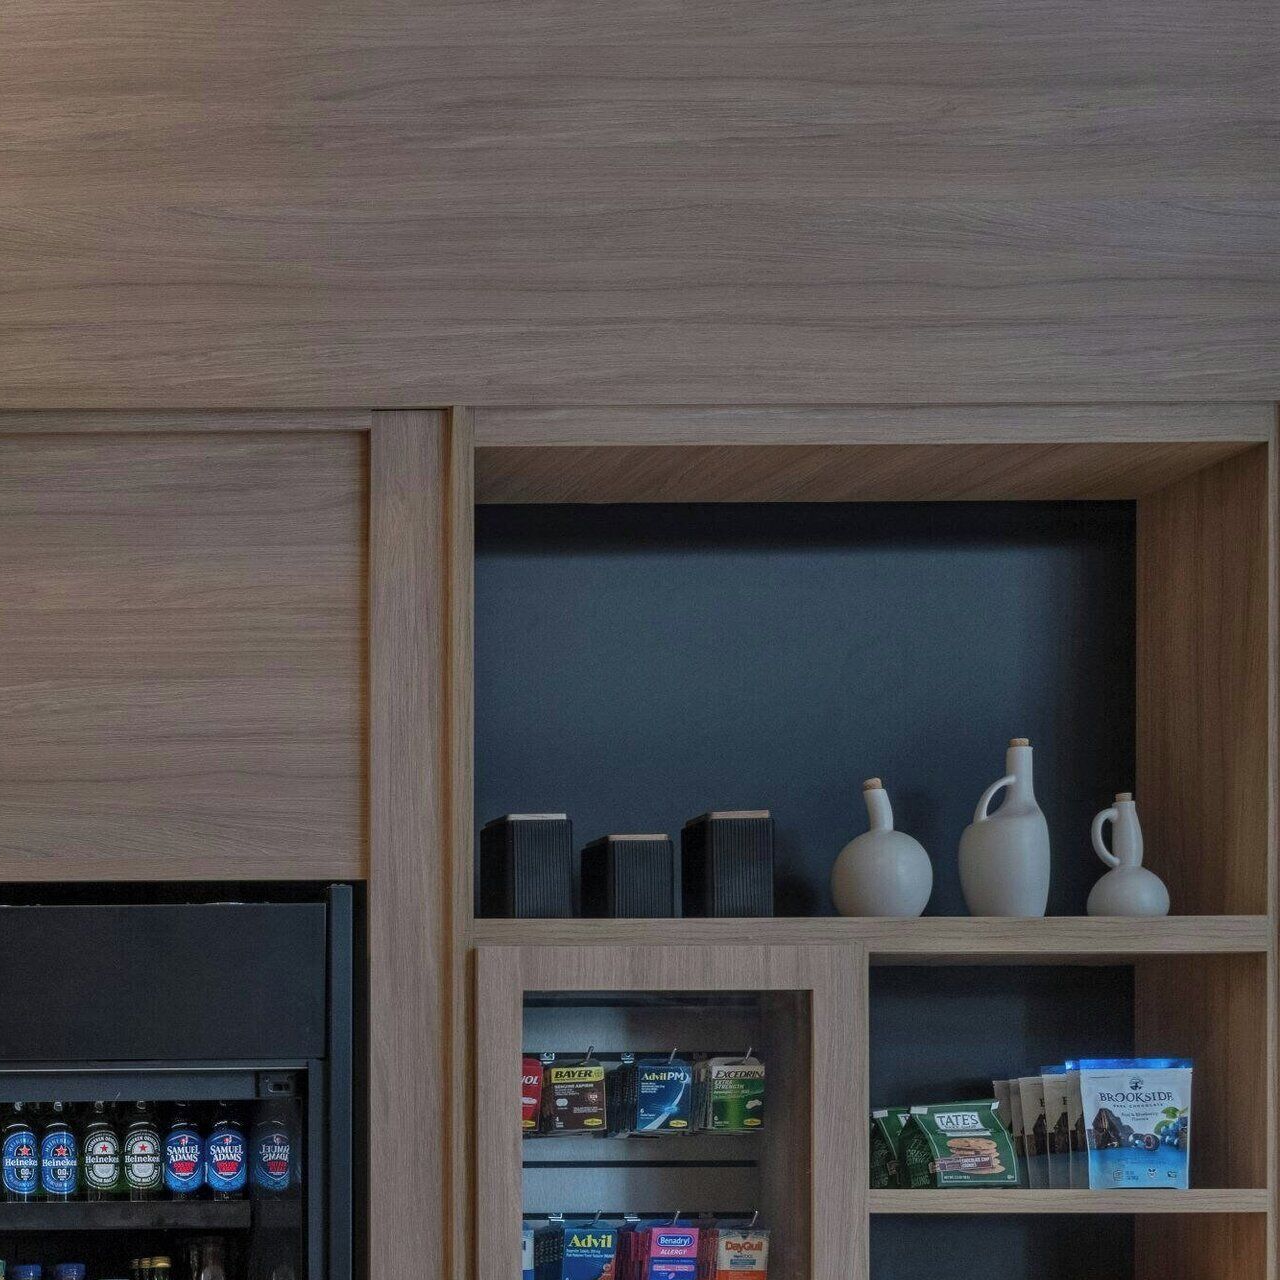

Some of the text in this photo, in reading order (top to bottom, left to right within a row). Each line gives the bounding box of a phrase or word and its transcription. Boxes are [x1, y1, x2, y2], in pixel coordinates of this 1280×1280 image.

[554, 1070, 592, 1079] BAYER
[641, 1072, 684, 1081] Advil PM
[714, 1070, 763, 1079] EXCEDRIN
[1099, 1091, 1174, 1103] BROOKSIDE
[938, 1113, 981, 1128] TATE'S
[167, 1145, 200, 1156] SAMUEL
[210, 1144, 244, 1155] SAMUEL
[170, 1154, 198, 1163] ADAMS
[213, 1154, 241, 1162] ADAMS
[568, 1234, 613, 1248] Advil
[660, 1237, 691, 1246] Benadryl
[725, 1241, 763, 1253] DayQuil
